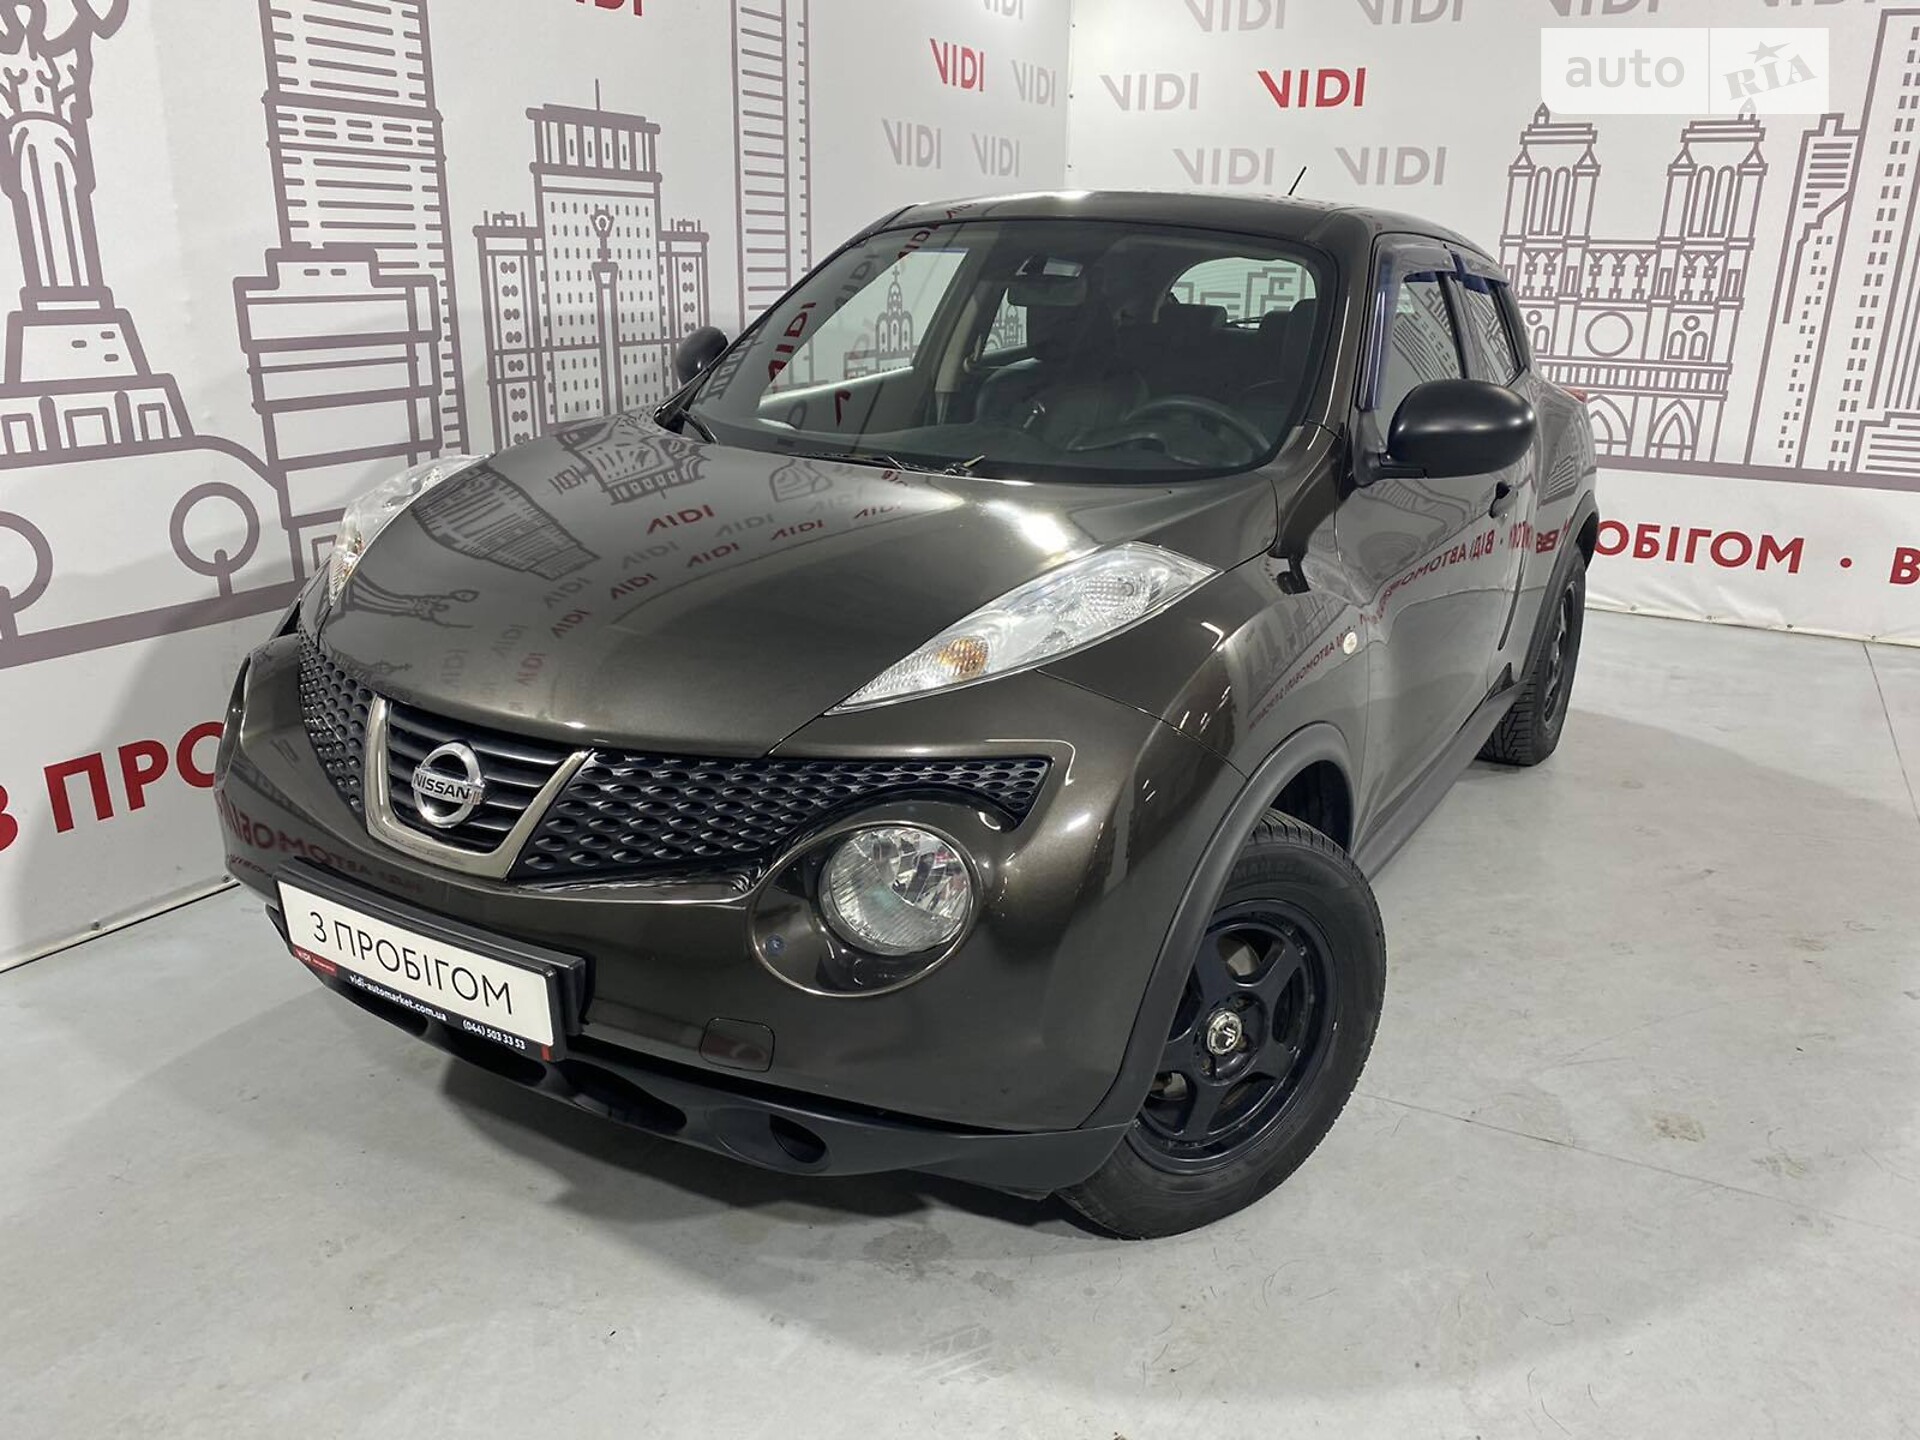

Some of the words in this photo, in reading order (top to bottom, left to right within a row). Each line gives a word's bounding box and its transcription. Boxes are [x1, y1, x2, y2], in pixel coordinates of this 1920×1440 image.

[930, 38, 984, 92] VIDI
[1011, 59, 1056, 108] VIDI
[1100, 72, 1199, 111] VIDI
[1258, 67, 1366, 108] VIDI
[881, 118, 942, 169] VIDI
[970, 133, 1020, 177] VIDI
[1173, 147, 1275, 186] VIDI
[1334, 146, 1447, 187] VIDI
[413, 773, 470, 800] NISSAN
[310, 911, 327, 943] З
[334, 920, 513, 1015] ПРОБІГОМ
[349, 974, 448, 1022] vidi-automarket.com.ua
[462, 1019, 486, 1036] (044)
[487, 1029, 501, 1042] 503
[501, 1034, 514, 1046] 33
[514, 1038, 526, 1050] 53
